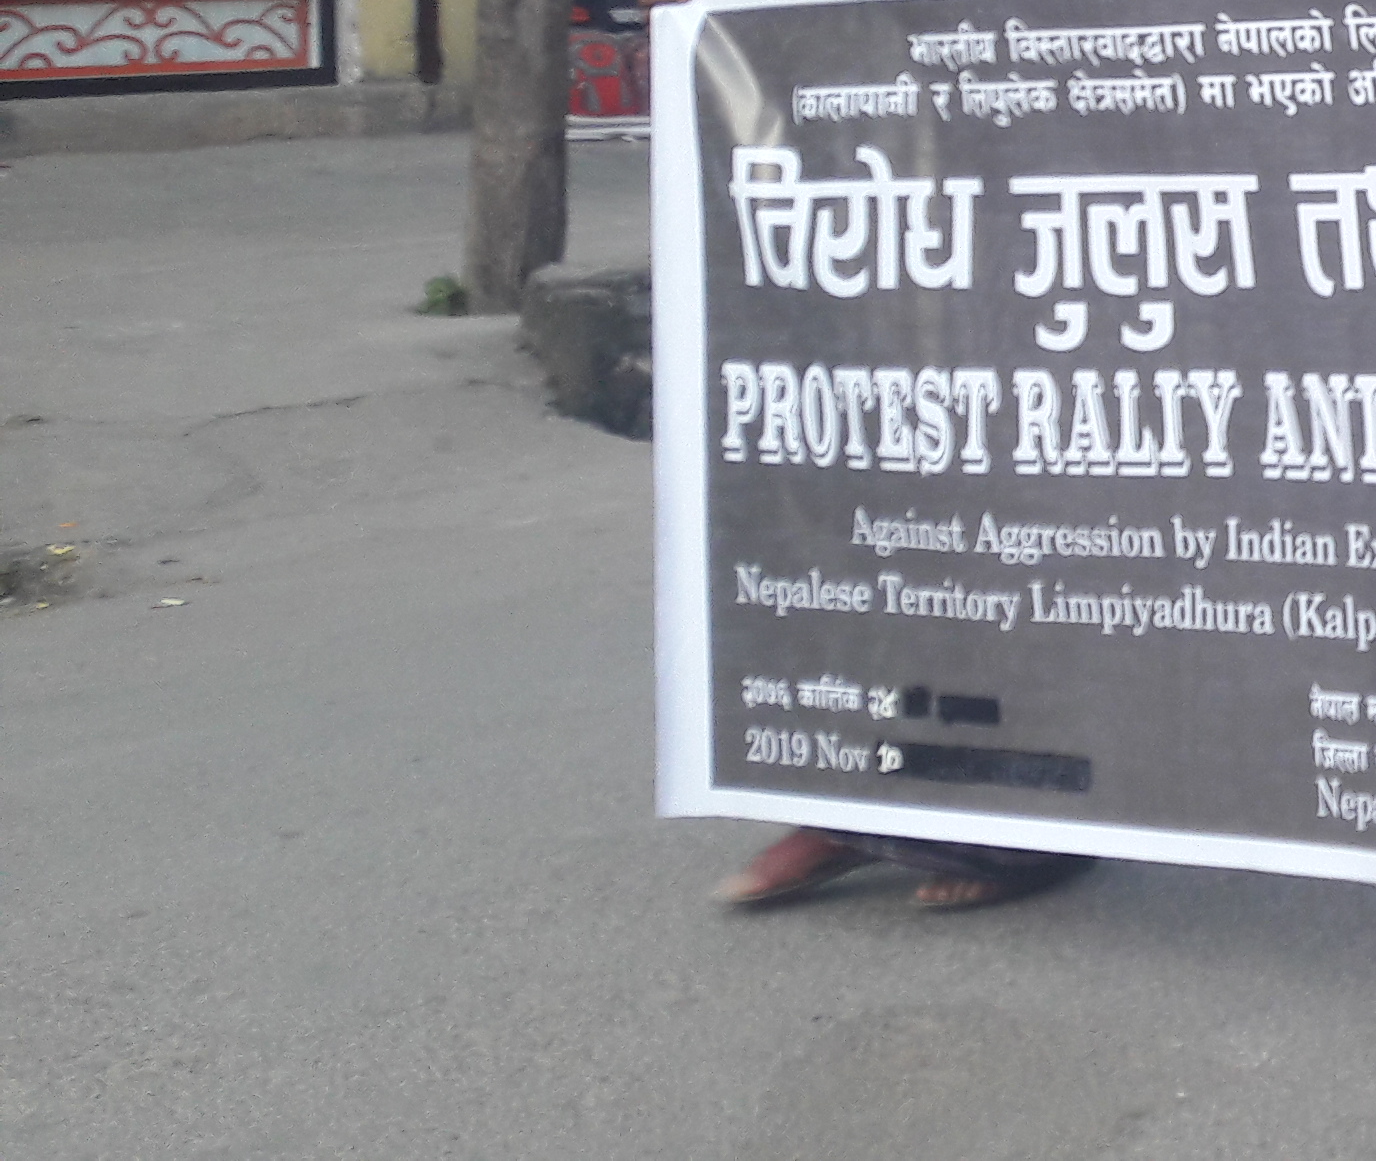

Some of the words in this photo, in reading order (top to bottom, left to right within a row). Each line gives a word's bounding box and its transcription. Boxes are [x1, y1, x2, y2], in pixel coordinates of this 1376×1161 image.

[1214, 8, 1334, 58] नेपालको
[929, 82, 952, 121] र
[1196, 74, 1237, 108] मा
[1245, 61, 1335, 116] भएको
[728, 141, 984, 298] विरोध
[1008, 173, 1259, 352] जुलुस
[721, 361, 1002, 476] PROTEST
[851, 506, 968, 557] Against
[973, 511, 1165, 566] Aggression
[1170, 514, 1217, 569] by
[1224, 516, 1337, 566] Indian
[735, 563, 873, 617] Nepalese
[877, 571, 1022, 632] Territory
[1027, 580, 1276, 637] Limpiyadhura
[745, 727, 811, 767] 2019
[814, 731, 871, 772] Nov
